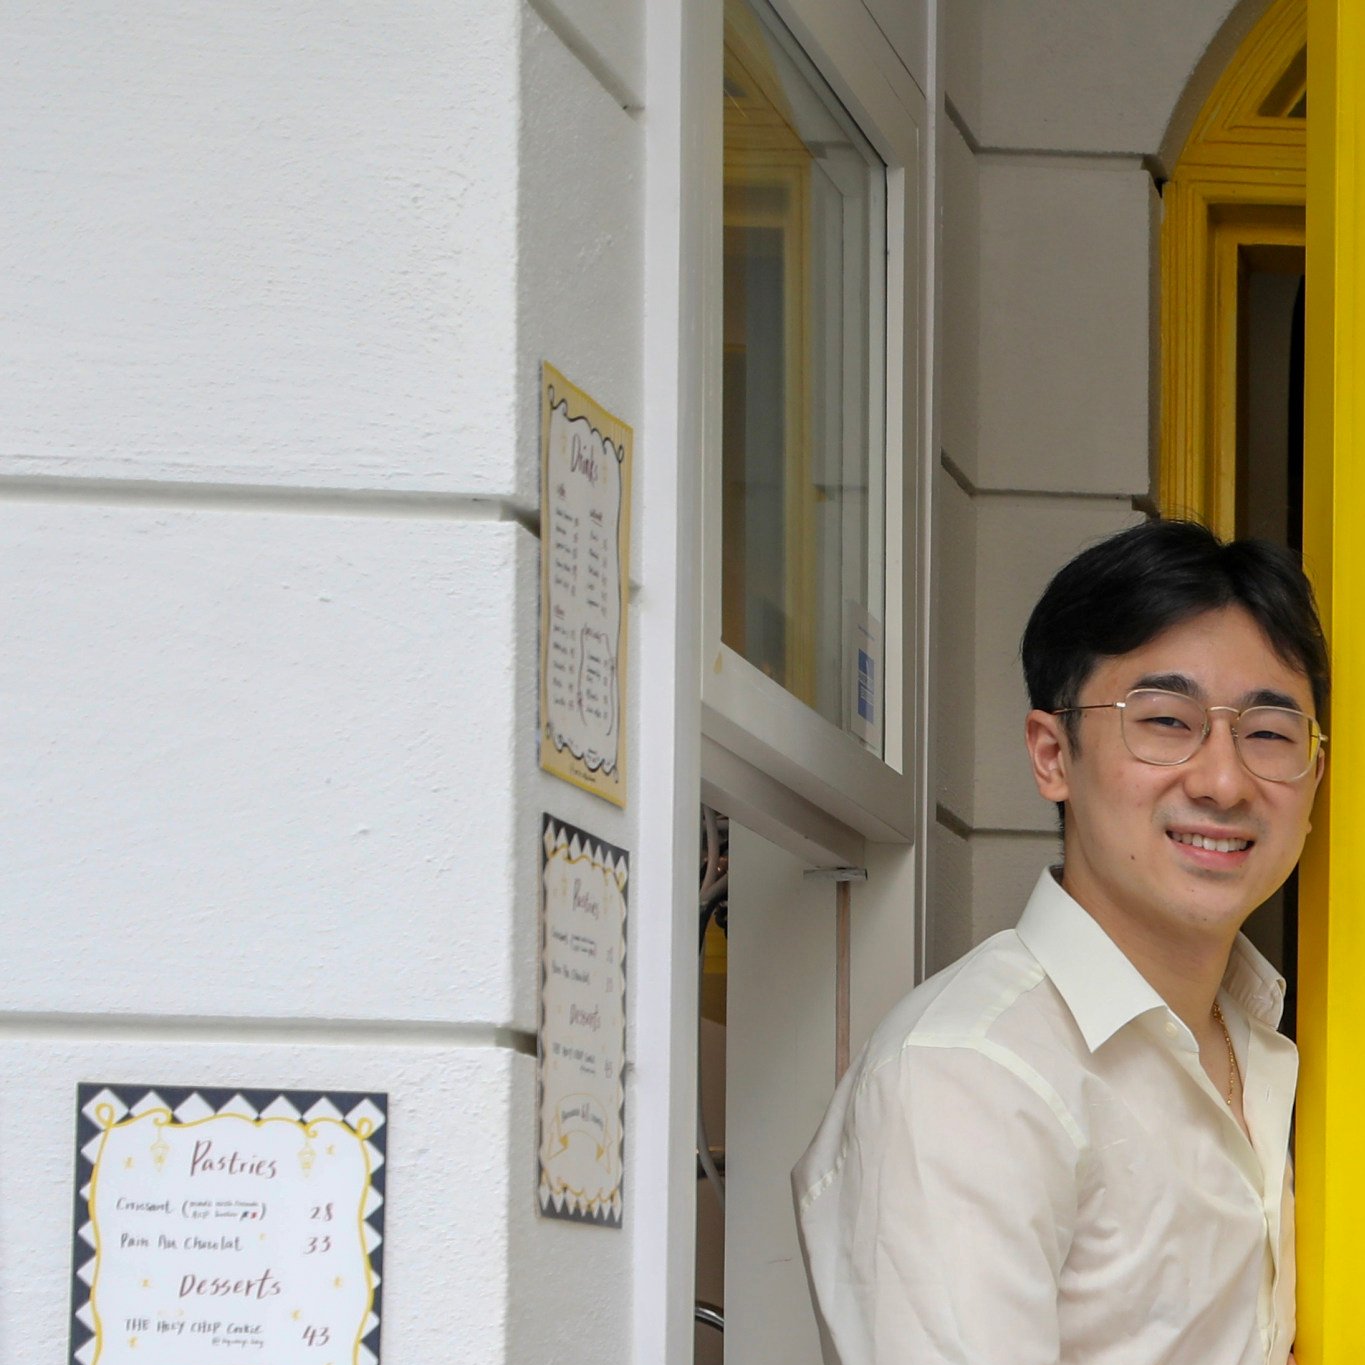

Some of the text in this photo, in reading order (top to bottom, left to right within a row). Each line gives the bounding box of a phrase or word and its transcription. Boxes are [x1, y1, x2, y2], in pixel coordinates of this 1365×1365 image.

[190, 1139, 278, 1179] Pastries
[309, 1202, 335, 1221] 28
[120, 1232, 149, 1249] Pain
[303, 1235, 333, 1255] 33
[178, 1268, 282, 1300] Desserts
[125, 1318, 151, 1332] THE
[302, 1324, 331, 1347] 43
